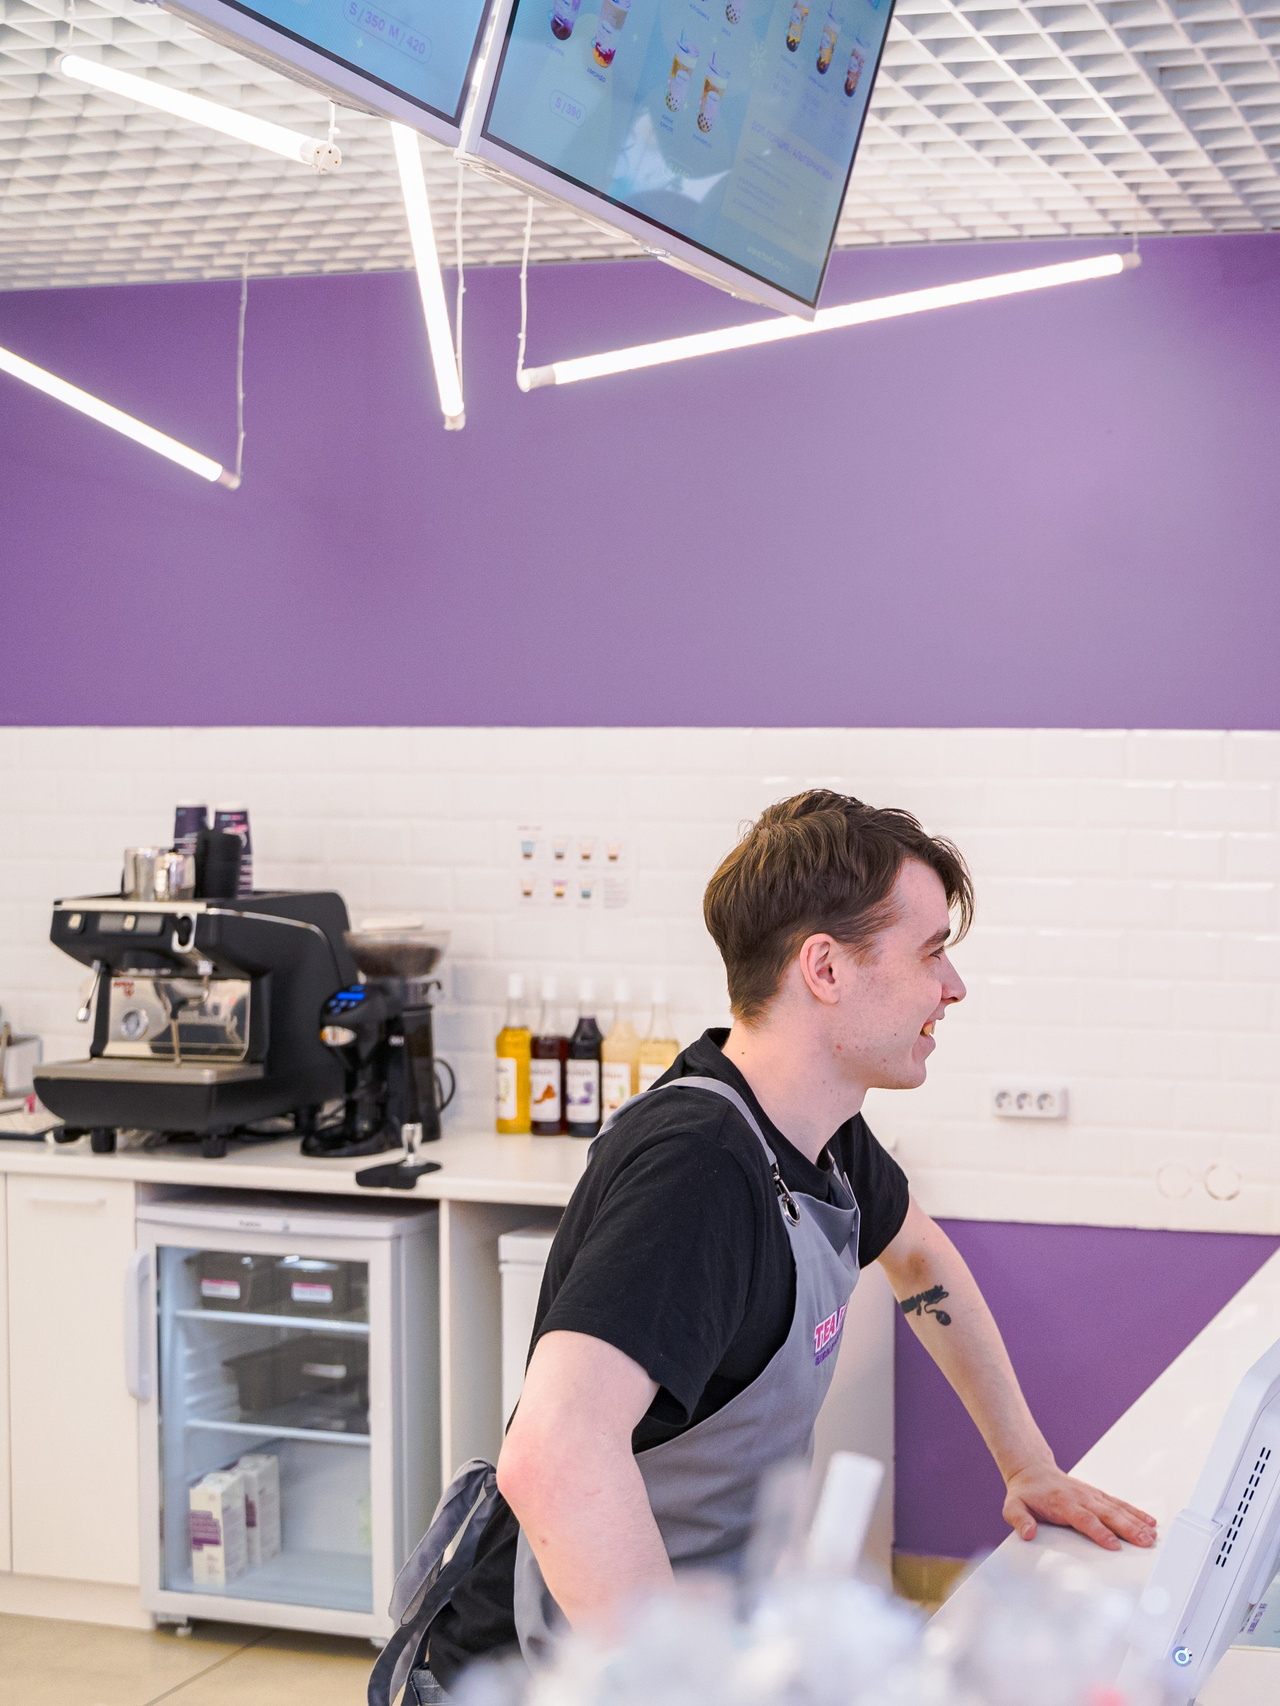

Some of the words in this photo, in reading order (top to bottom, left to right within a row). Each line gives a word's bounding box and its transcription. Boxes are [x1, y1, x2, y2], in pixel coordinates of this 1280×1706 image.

[349, 2, 358, 16] S
[364, 11, 386, 32] 350
[388, 25, 400, 38] M
[406, 36, 426, 55] 420
[554, 96, 562, 109] S
[814, 1310, 838, 1353] TEA
